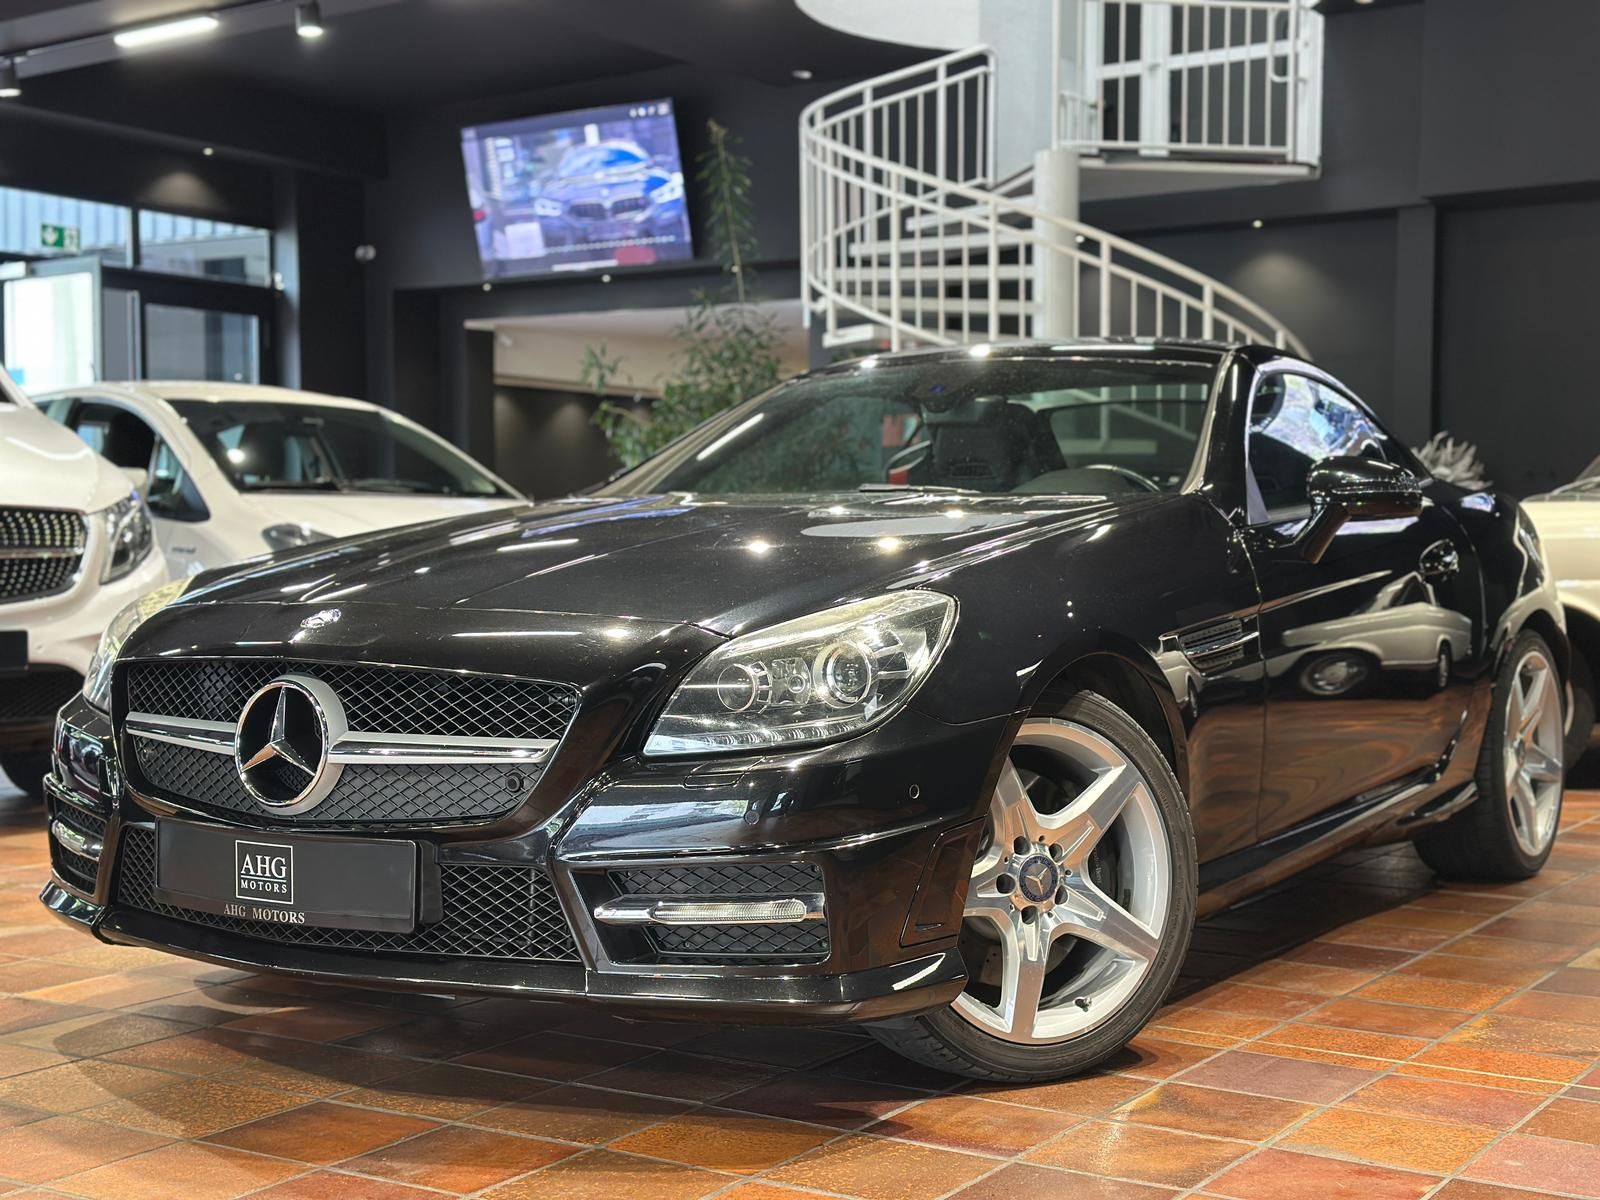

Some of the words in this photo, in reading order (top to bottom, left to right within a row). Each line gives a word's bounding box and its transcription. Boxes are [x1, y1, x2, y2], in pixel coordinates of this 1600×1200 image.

[240, 853, 287, 879] AHG
[240, 879, 288, 894] MOTORS
[223, 903, 246, 917] AHG
[252, 907, 305, 924] MOTORS
